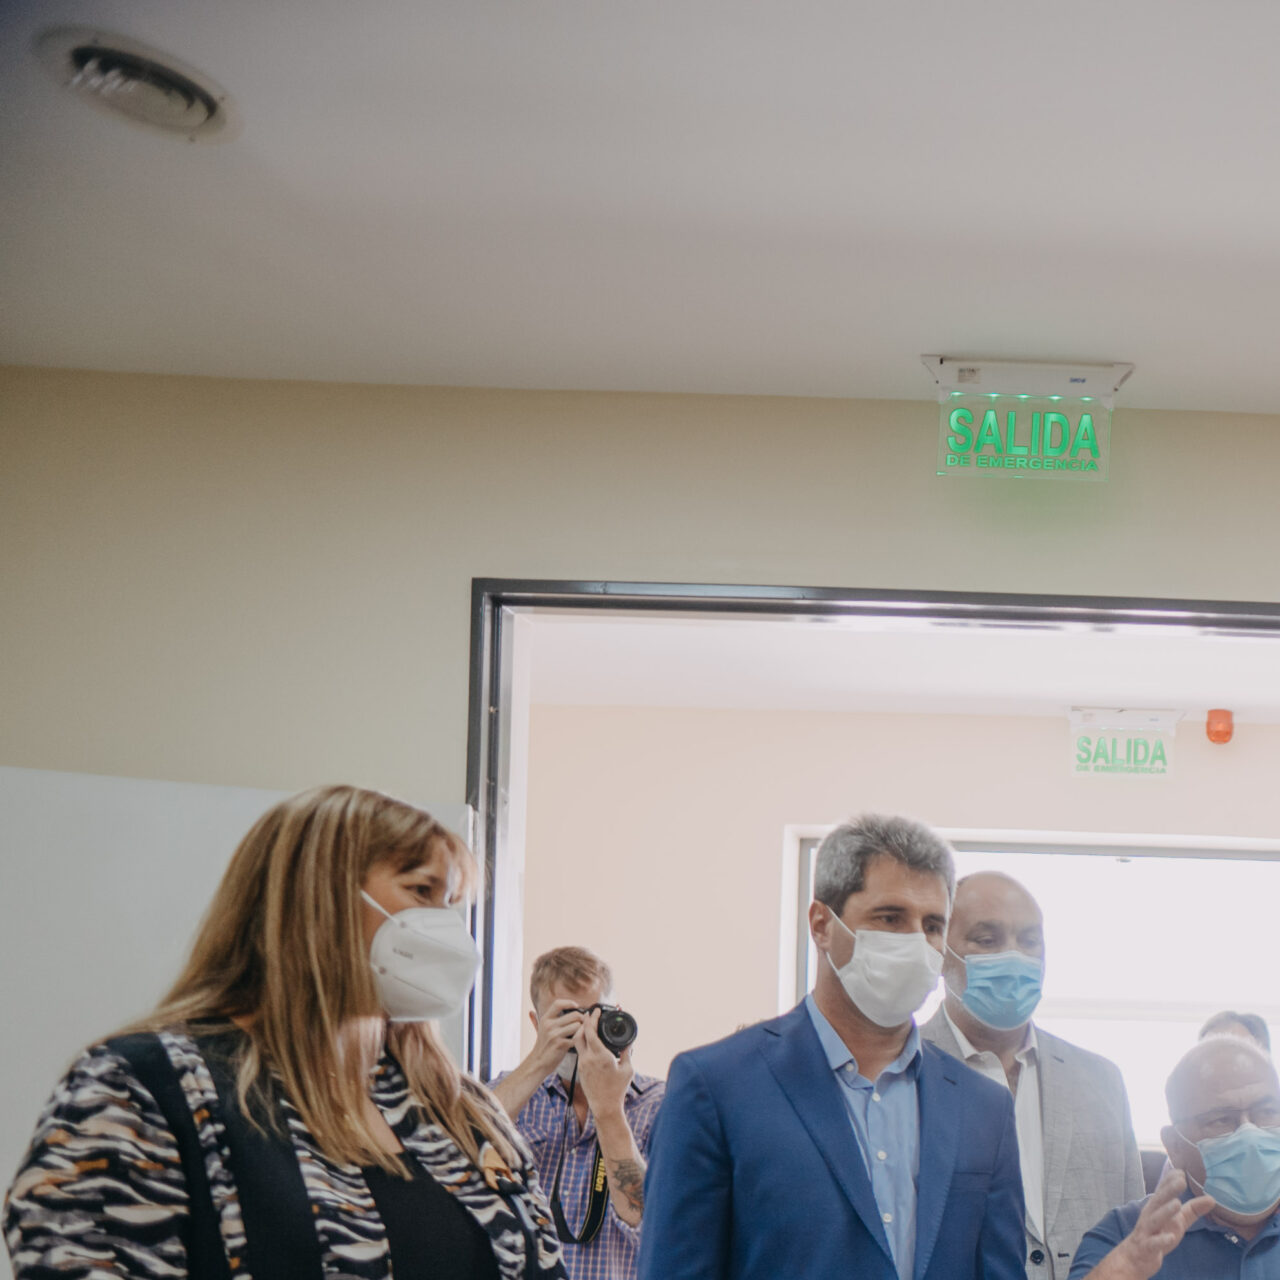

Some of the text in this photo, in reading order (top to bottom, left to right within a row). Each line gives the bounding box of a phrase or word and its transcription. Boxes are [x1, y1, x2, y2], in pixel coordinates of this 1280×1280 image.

[947, 408, 1101, 459] SALIDA
[946, 454, 1099, 472] DE EMERGENCIA
[1076, 735, 1167, 766] SALIDA
[594, 1157, 606, 1192] Nikon
